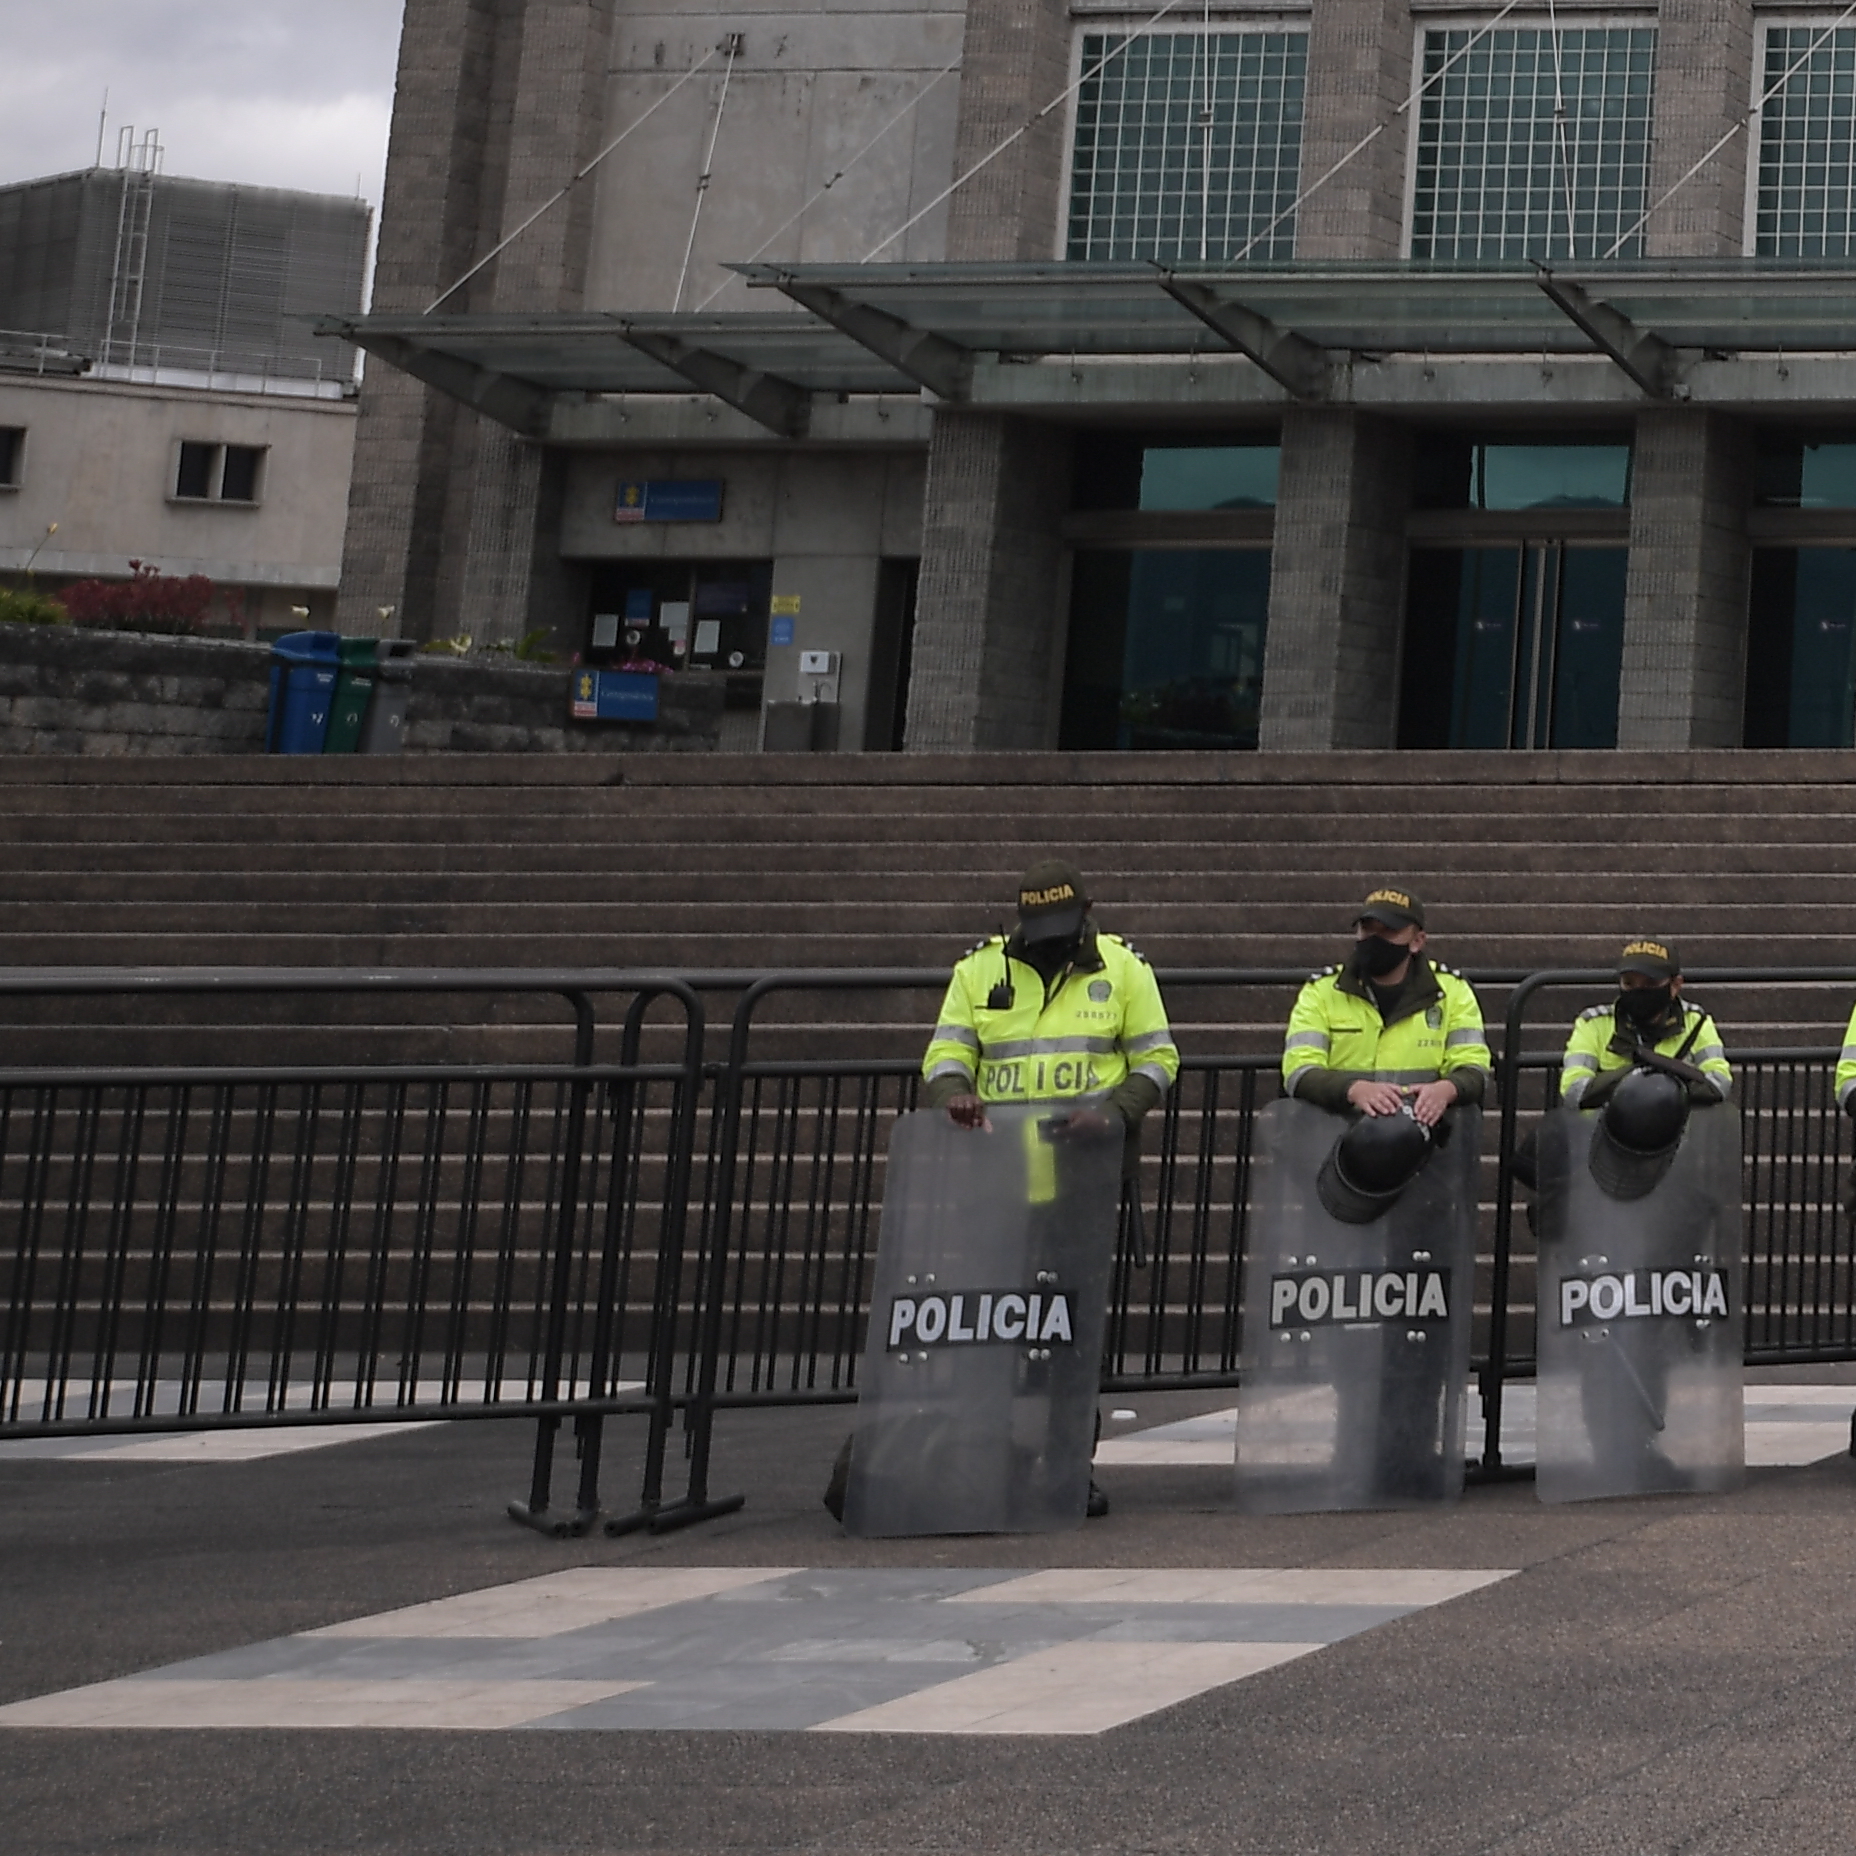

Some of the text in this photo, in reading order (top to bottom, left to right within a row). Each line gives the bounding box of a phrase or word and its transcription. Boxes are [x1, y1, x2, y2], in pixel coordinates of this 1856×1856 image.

[1021, 884, 1075, 905] POLICIA
[889, 1293, 1072, 1346] POLICIA
[1271, 1272, 1447, 1325] POLICIA
[1561, 1271, 1727, 1325] POLICIA
